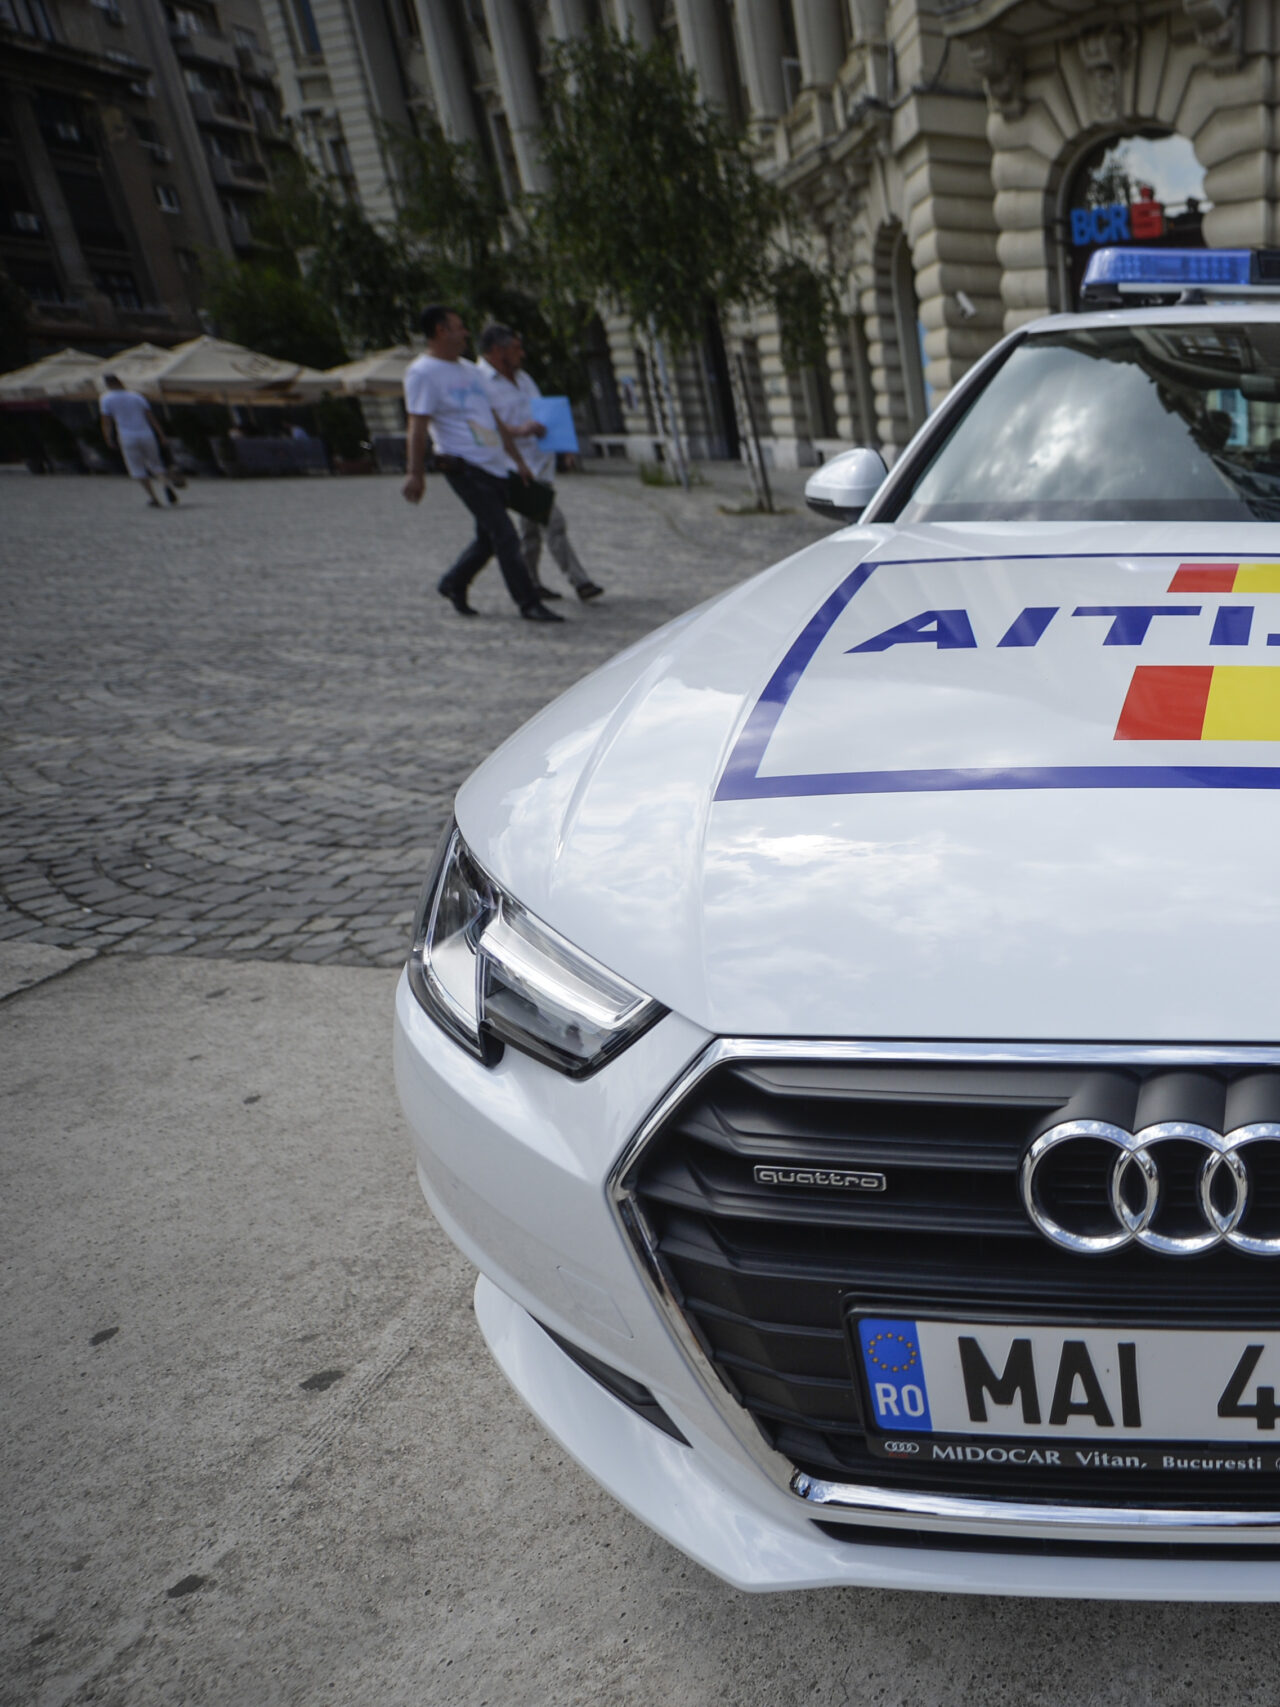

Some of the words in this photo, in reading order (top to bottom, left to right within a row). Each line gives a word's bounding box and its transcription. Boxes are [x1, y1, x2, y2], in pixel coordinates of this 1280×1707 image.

[1070, 204, 1131, 246] BCR
[760, 1171, 879, 1188] quattro
[876, 1382, 925, 1418] RO
[957, 1336, 1142, 1428] MAI
[932, 1445, 1061, 1465] MIDOCAR
[1076, 1450, 1147, 1468] Vitan,
[1162, 1455, 1262, 1470] Bucuresti
